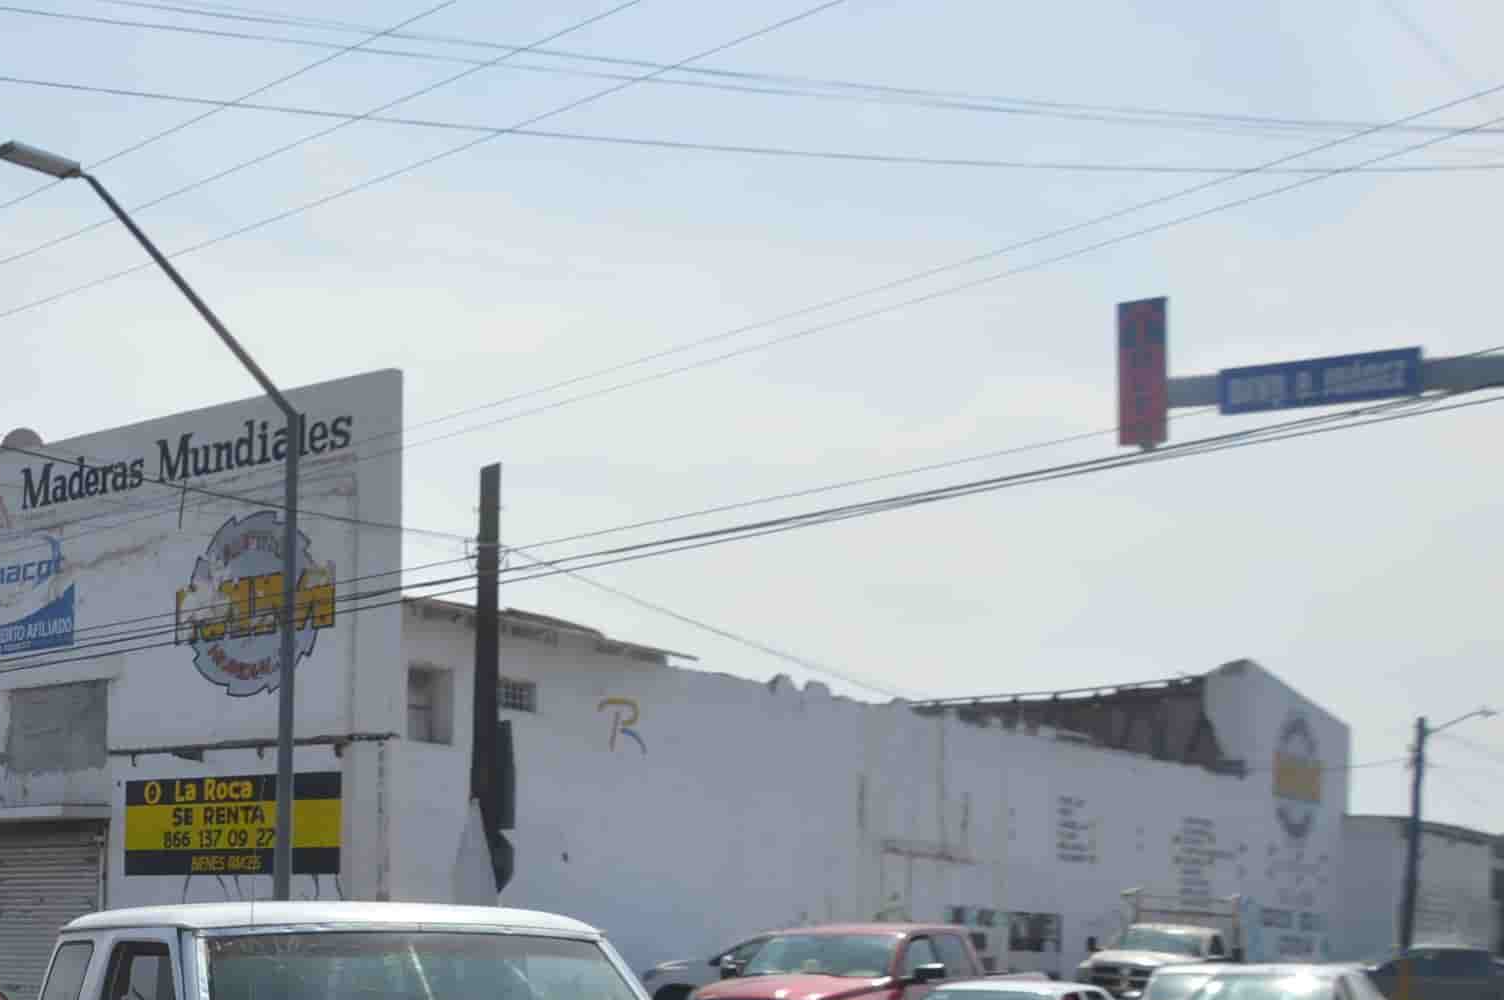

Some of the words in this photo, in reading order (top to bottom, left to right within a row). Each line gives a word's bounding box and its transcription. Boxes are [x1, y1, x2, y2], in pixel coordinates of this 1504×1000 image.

[21, 457, 145, 510] Maderas
[156, 413, 353, 483] Mundiales
[175, 780, 197, 802] La
[204, 777, 253, 801] Roca
[172, 807, 194, 827] SE
[203, 806, 265, 826] RENTA
